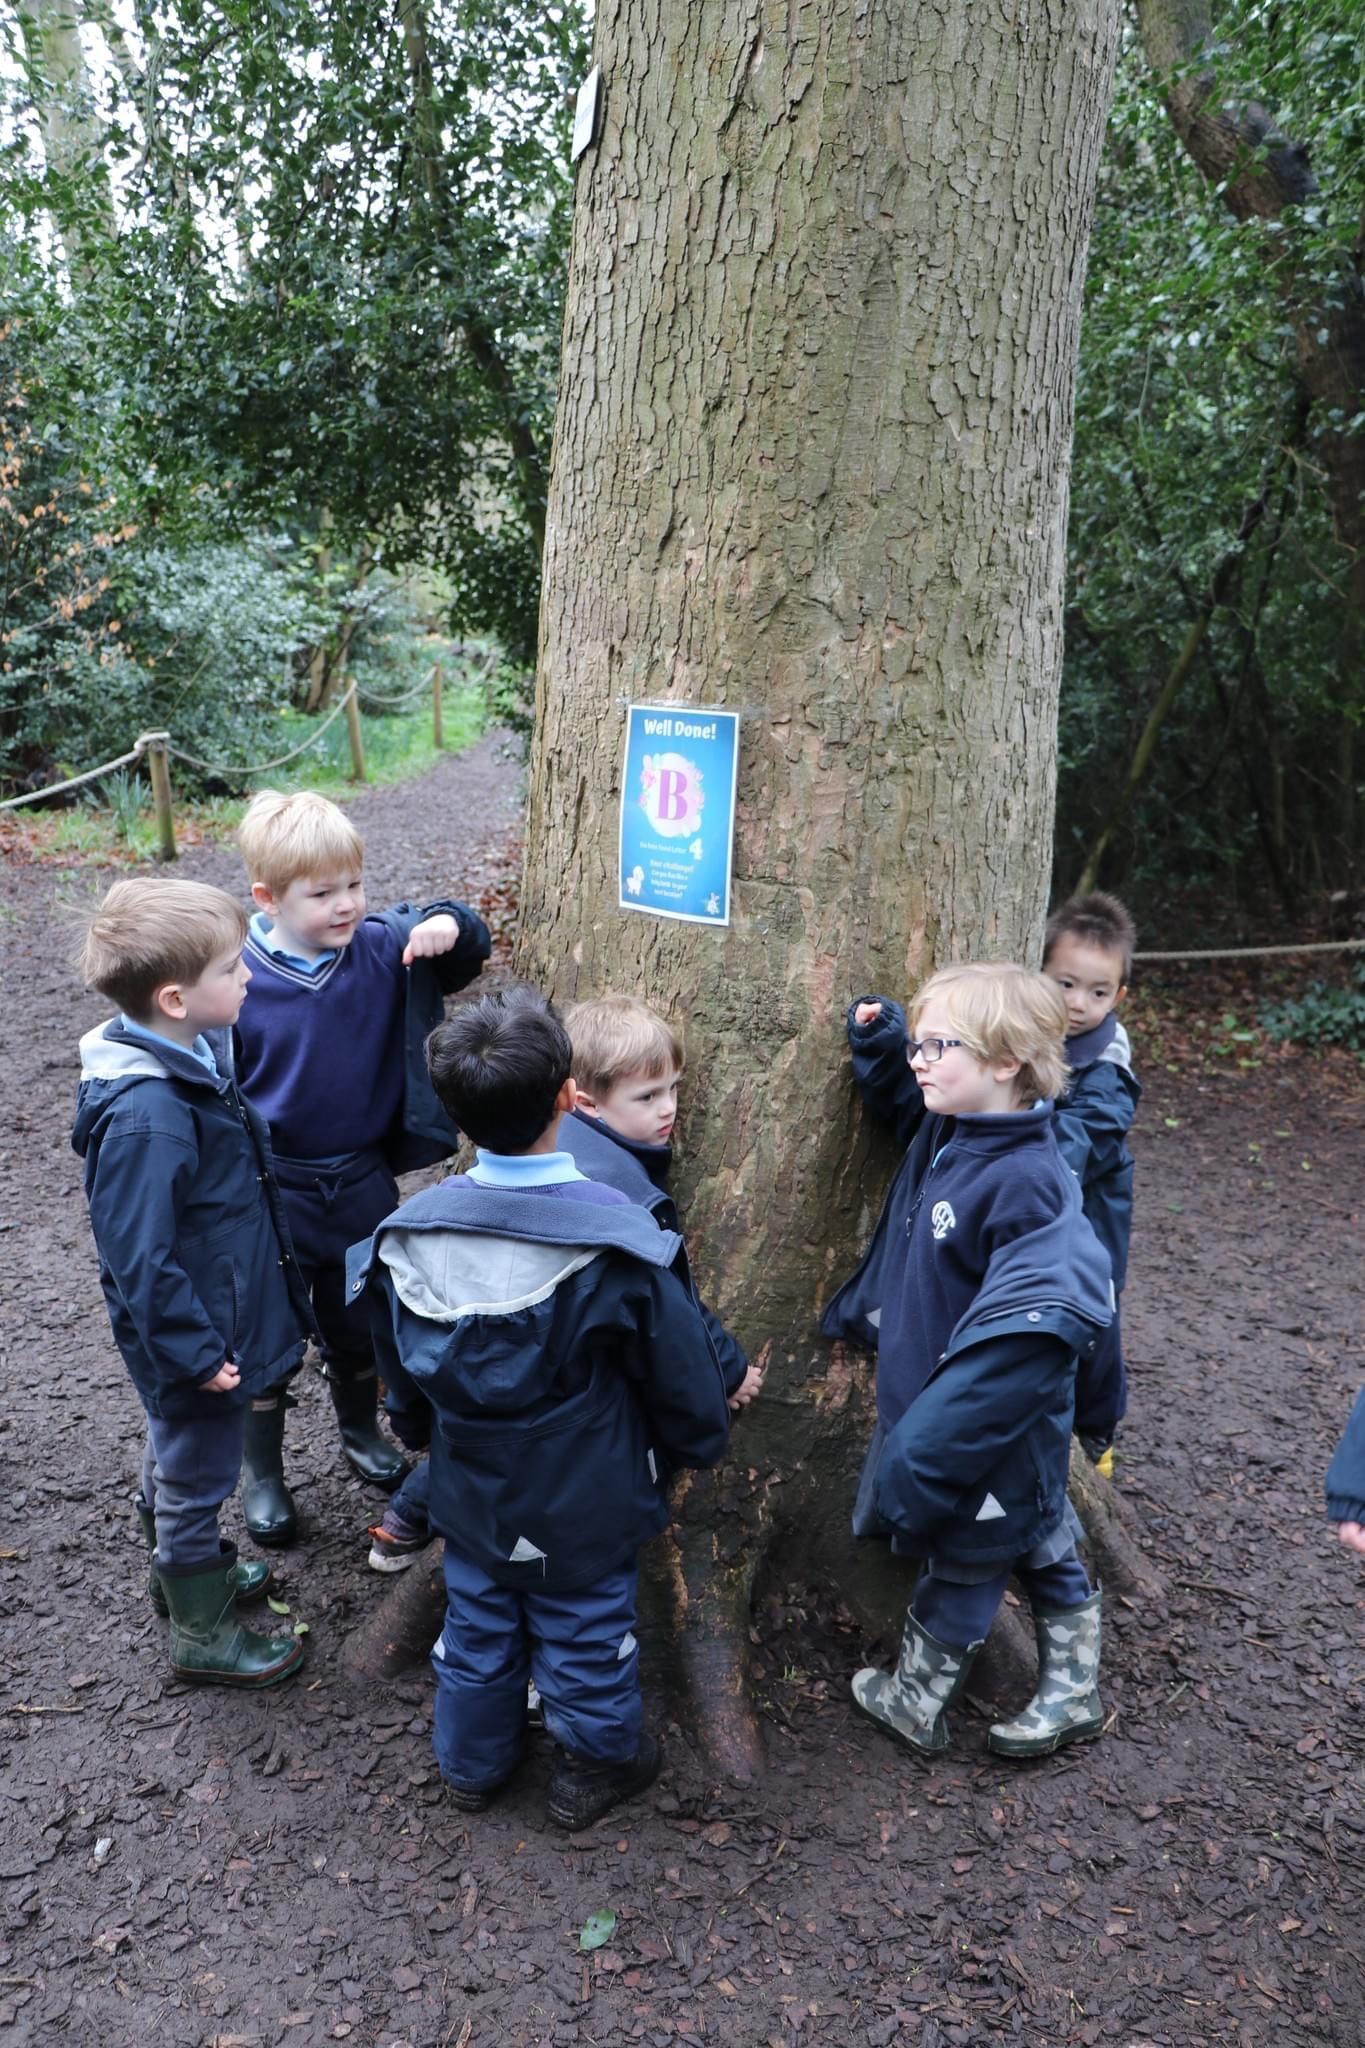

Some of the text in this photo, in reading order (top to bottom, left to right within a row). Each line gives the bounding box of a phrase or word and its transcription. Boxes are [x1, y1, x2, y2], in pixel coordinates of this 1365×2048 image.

[643, 719, 717, 740] Well Done!
[656, 769, 688, 820] B
